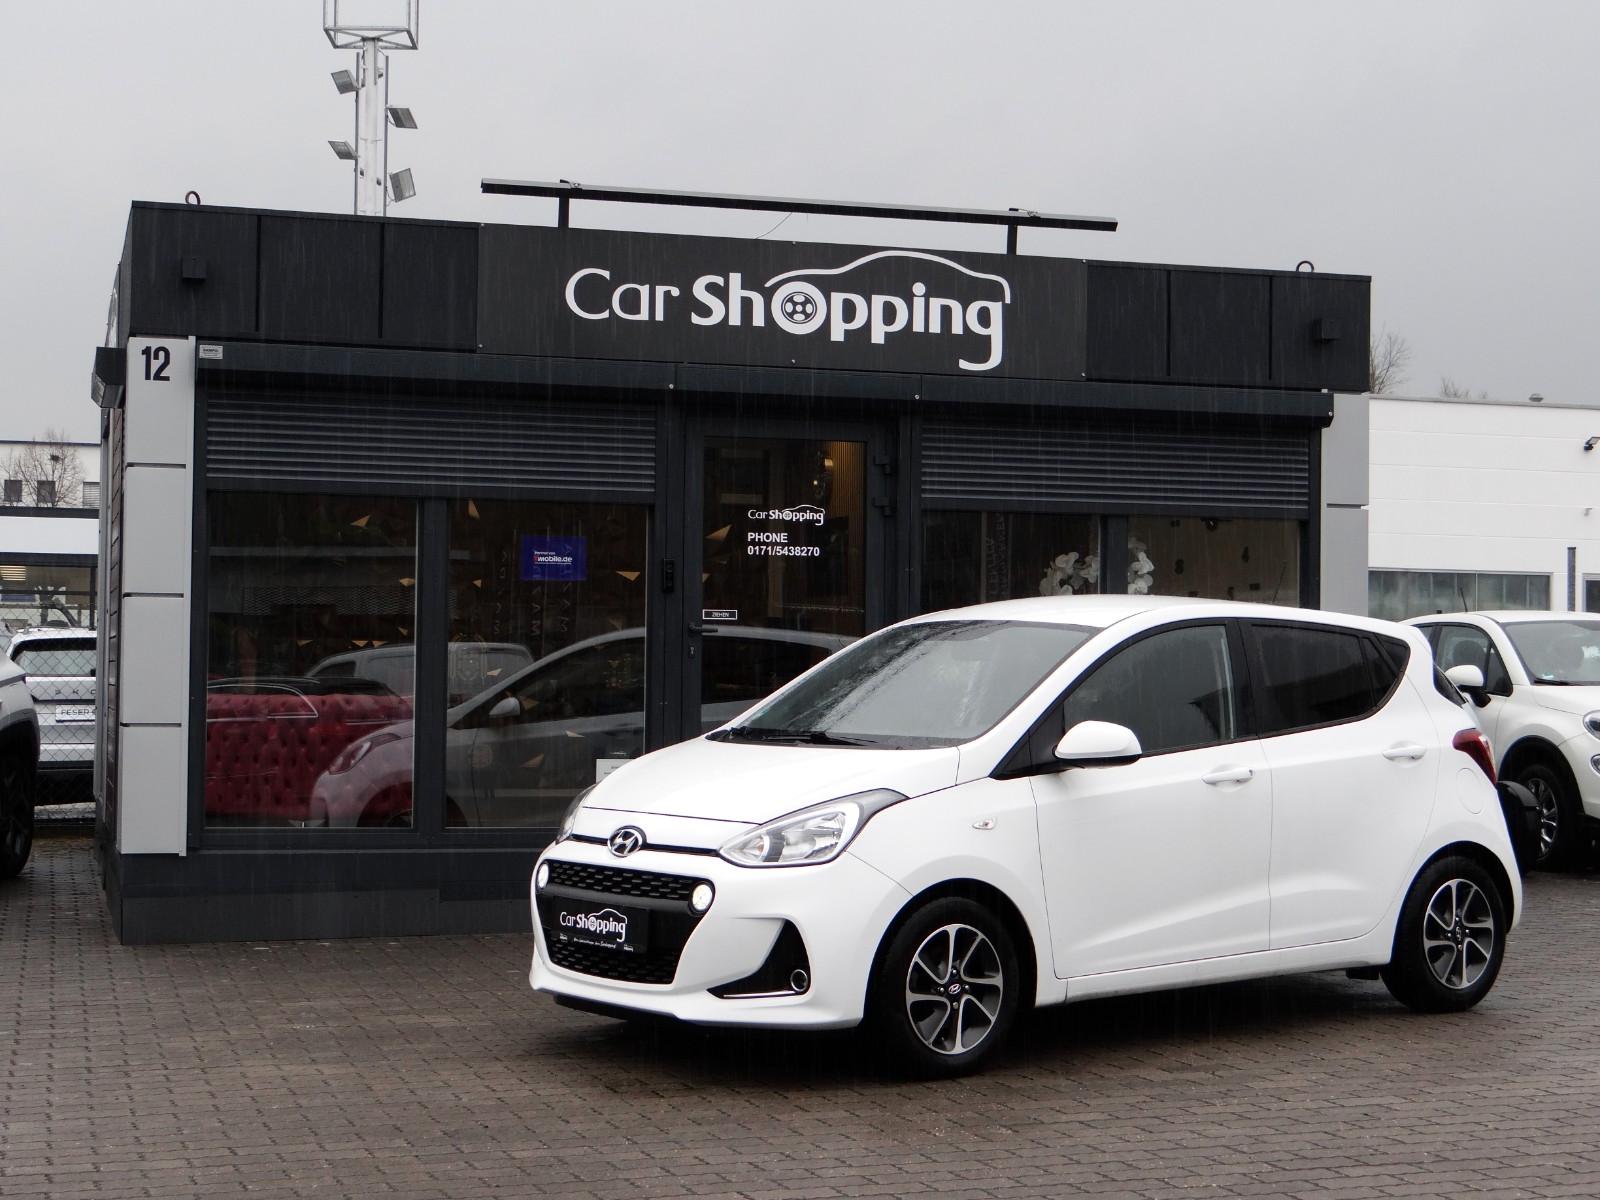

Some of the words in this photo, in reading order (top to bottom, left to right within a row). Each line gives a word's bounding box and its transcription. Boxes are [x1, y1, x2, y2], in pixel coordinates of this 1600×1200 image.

[565, 267, 680, 322] Car
[691, 272, 1004, 371] Shopping
[141, 345, 170, 381] 12
[747, 509, 768, 519] Car
[768, 508, 824, 526] Shopping
[747, 532, 789, 543] PHONE
[537, 555, 573, 563] mobile.de
[747, 545, 820, 557] 0171/5438270
[559, 911, 576, 927] Car
[576, 912, 626, 943] Shopping
